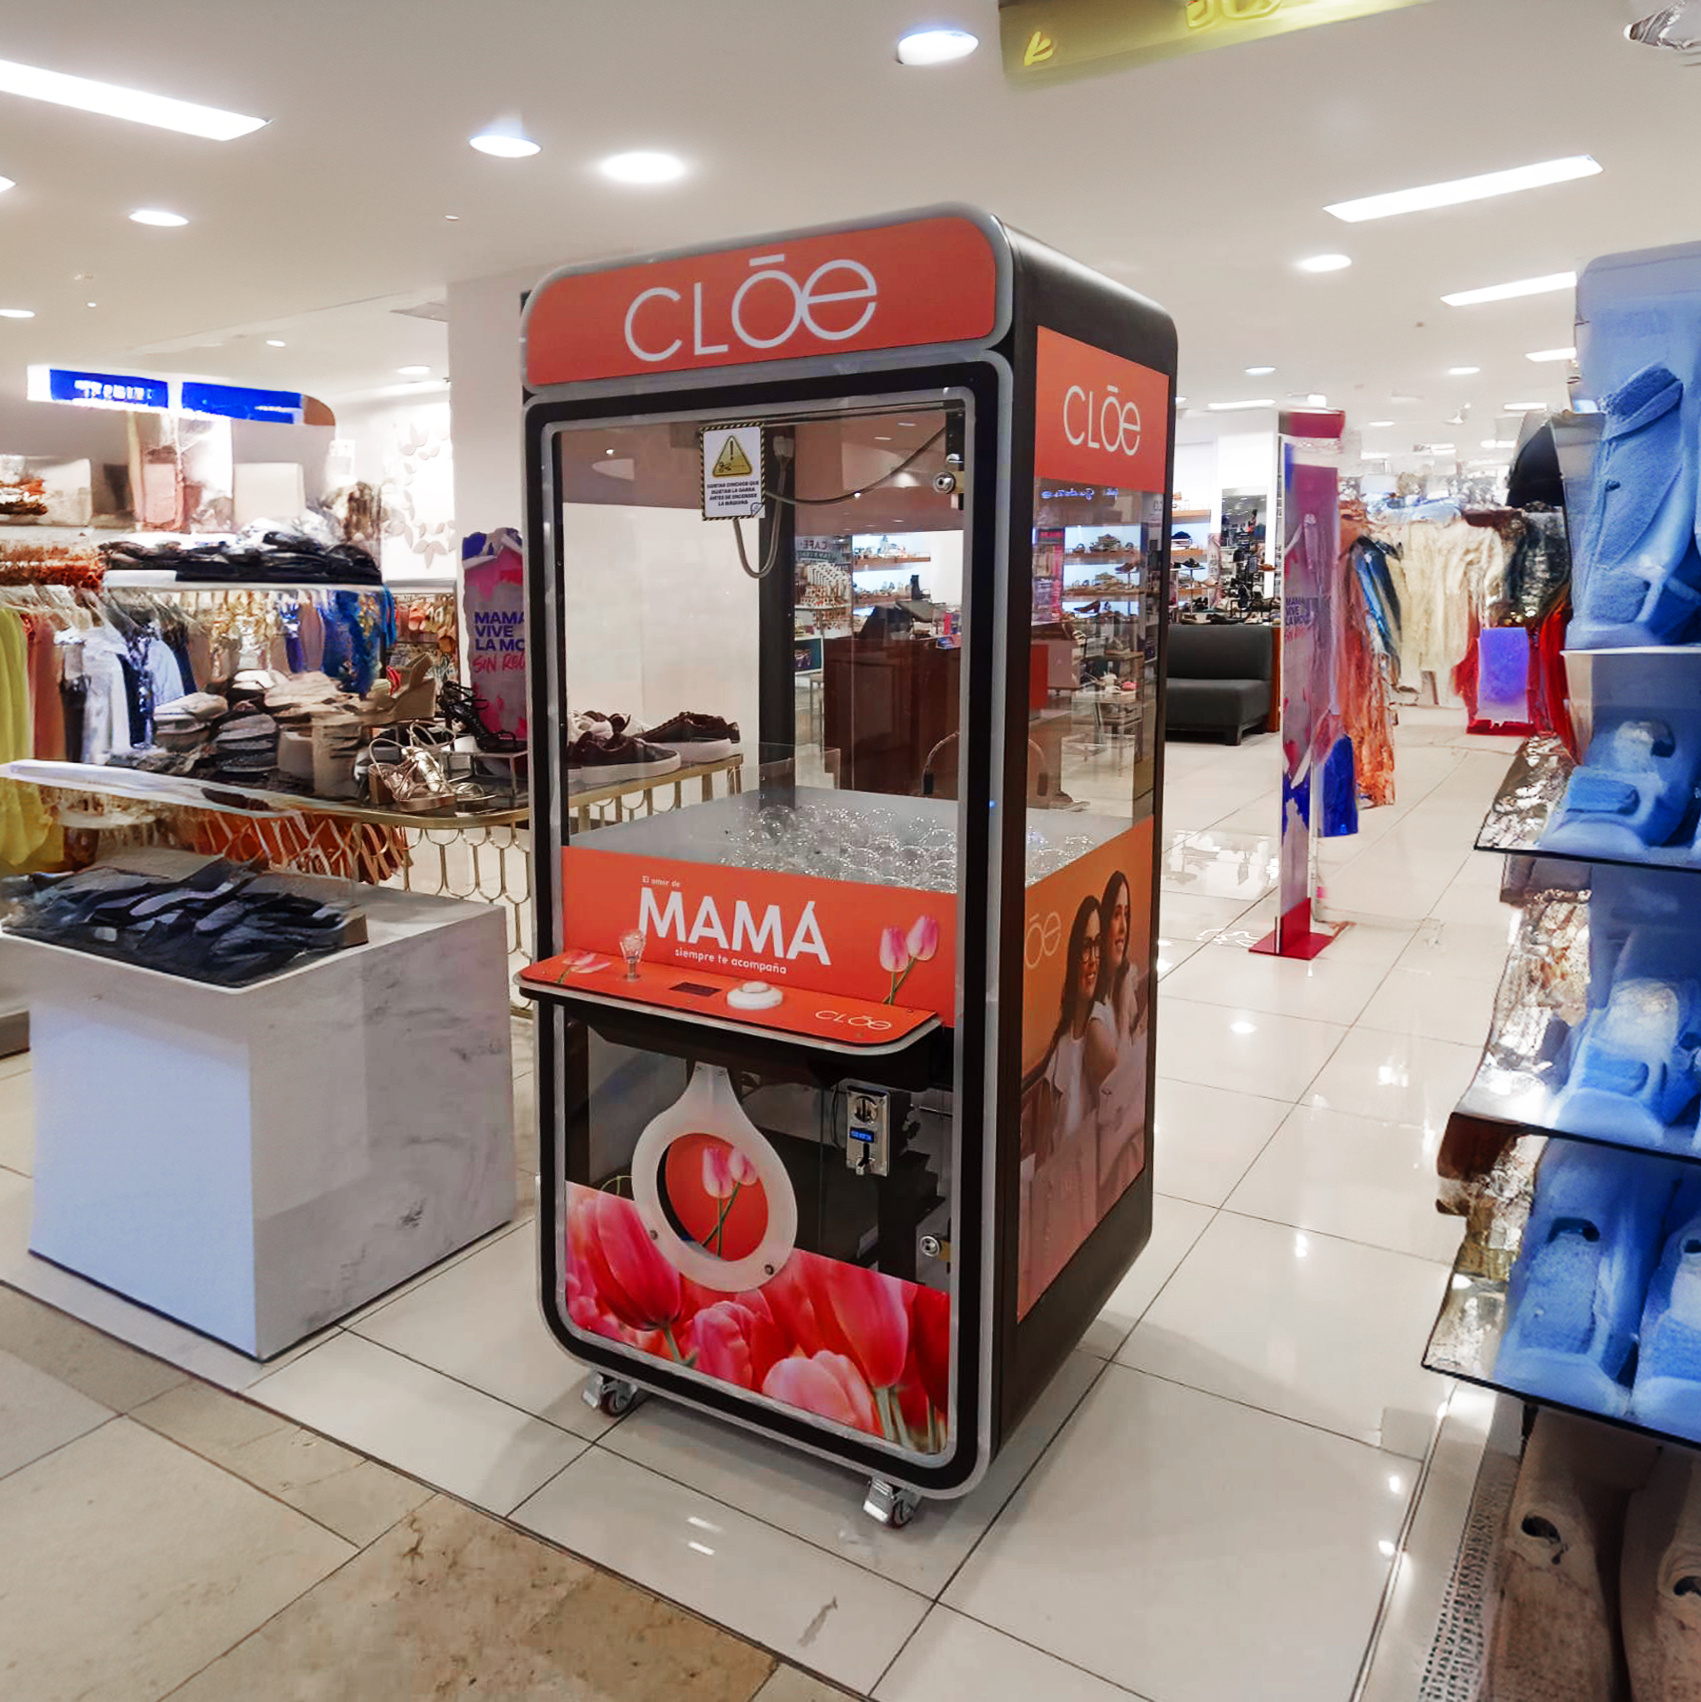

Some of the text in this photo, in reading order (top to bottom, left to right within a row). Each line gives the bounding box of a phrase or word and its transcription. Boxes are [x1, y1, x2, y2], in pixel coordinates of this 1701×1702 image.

[475, 625, 514, 638] VIVE
[475, 638, 497, 652] LA
[472, 653, 498, 674] SIN
[638, 886, 832, 966] MAMÁ
[674, 947, 788, 975] siempre te acompaña
